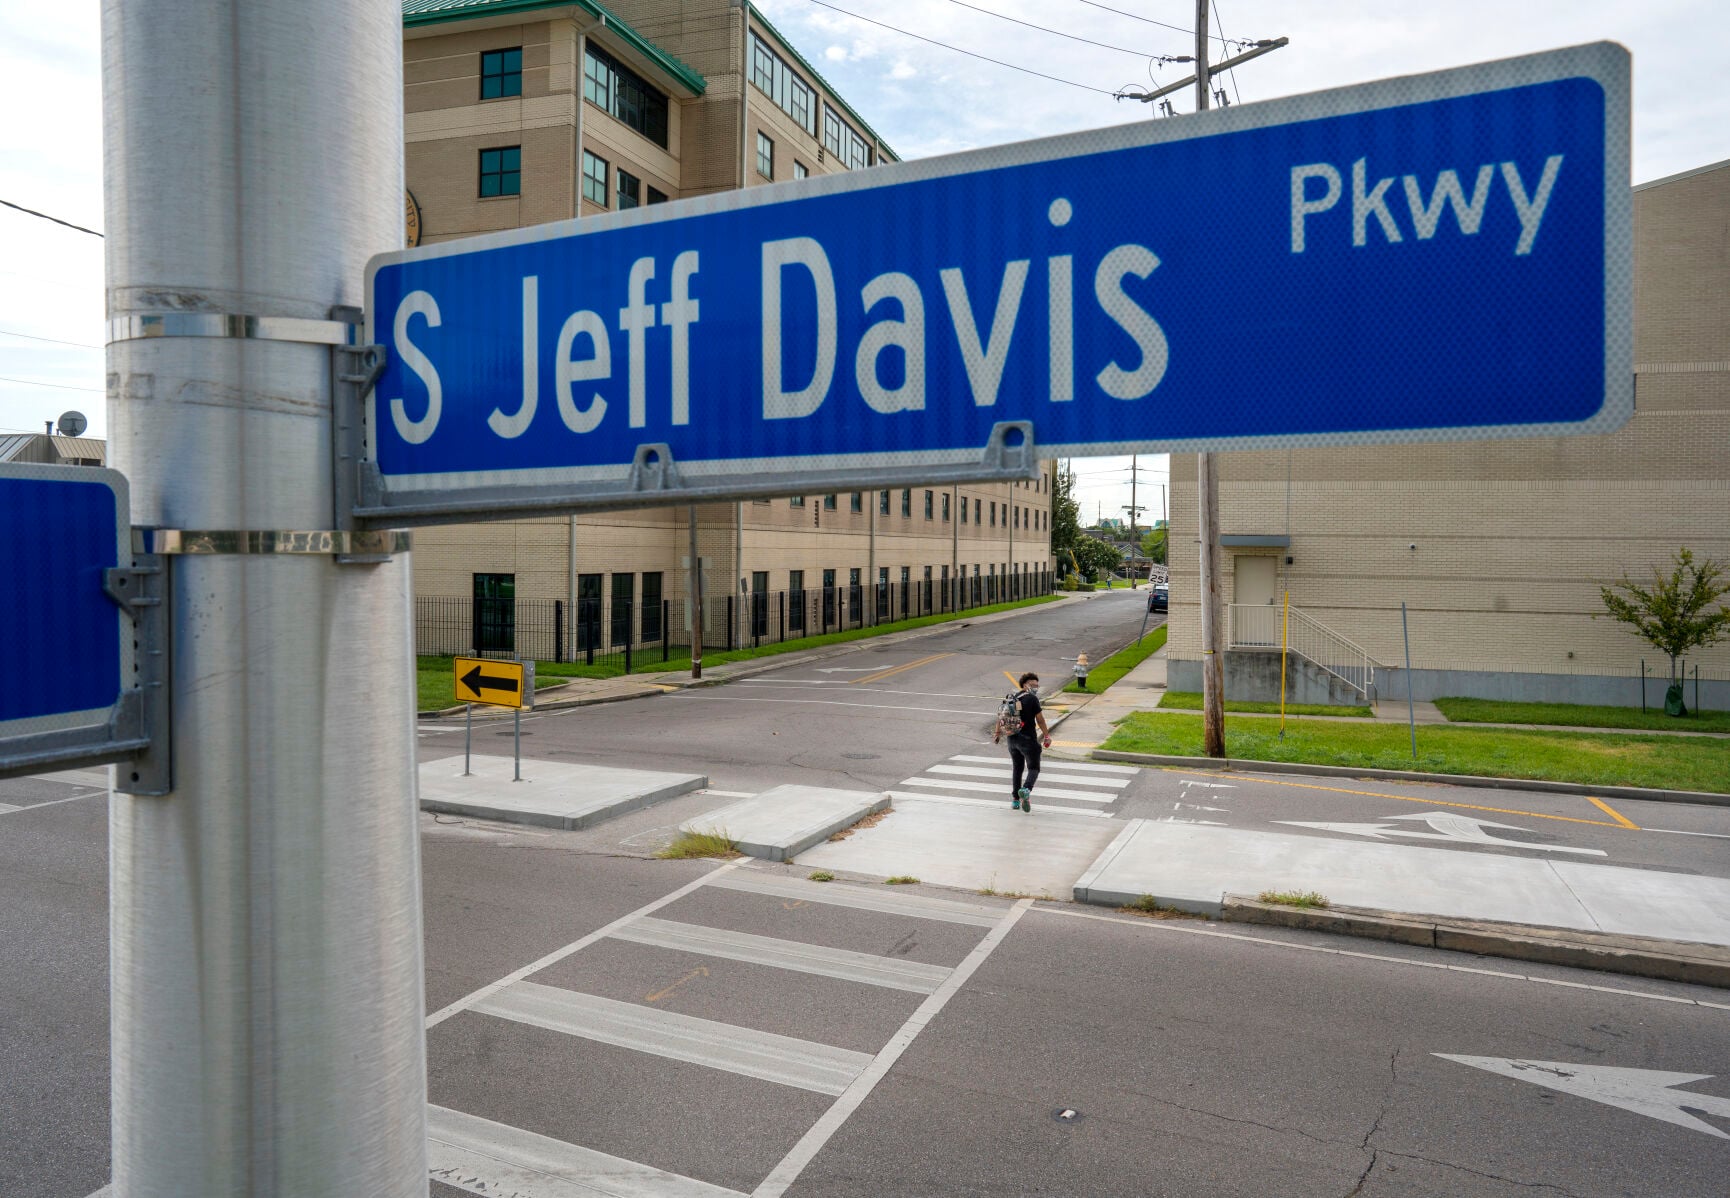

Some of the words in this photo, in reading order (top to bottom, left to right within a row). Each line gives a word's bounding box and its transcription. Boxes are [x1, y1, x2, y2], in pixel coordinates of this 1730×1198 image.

[390, 289, 442, 445] S
[487, 250, 700, 440] Jeff
[761, 198, 1170, 422] Davis
[1290, 156, 1564, 255] Pkwy
[1150, 574, 1164, 584] 25
